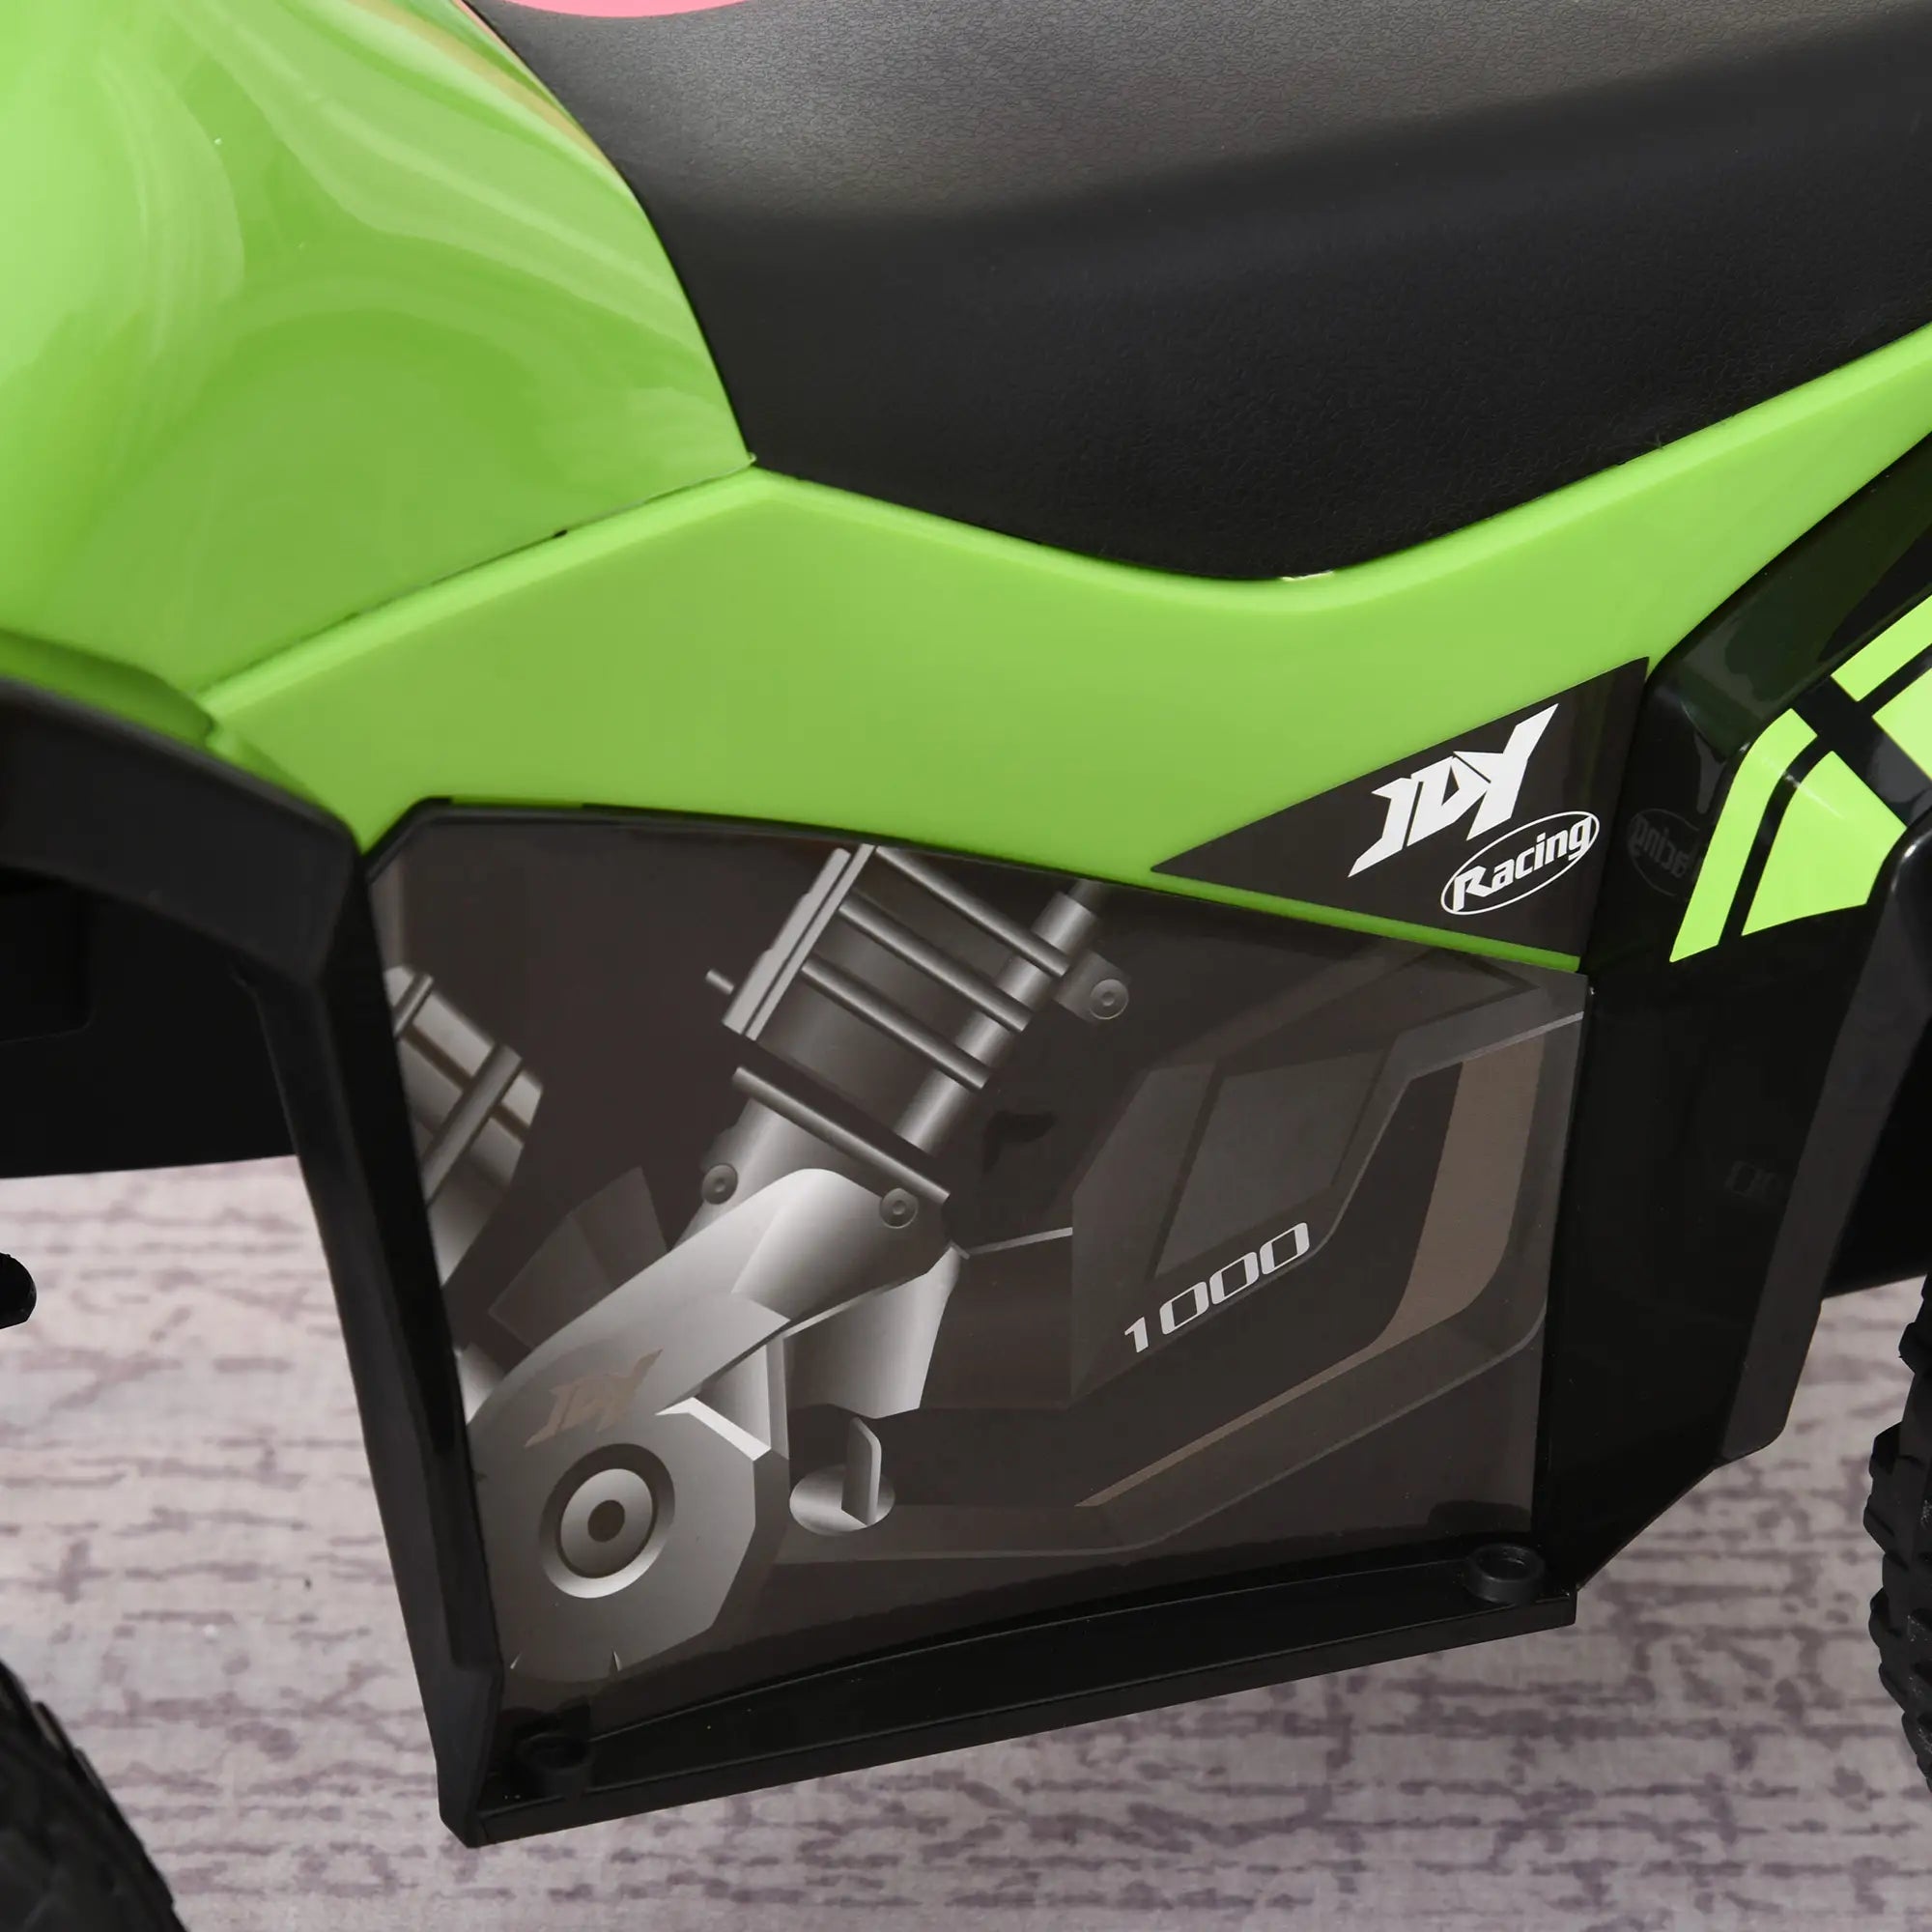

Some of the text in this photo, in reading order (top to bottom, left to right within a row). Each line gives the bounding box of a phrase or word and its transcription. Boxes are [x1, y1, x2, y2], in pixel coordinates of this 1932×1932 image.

[1348, 703, 1559, 878] JDY
[1452, 814, 1595, 912] Racing
[1124, 1222, 1310, 1353] 1000
